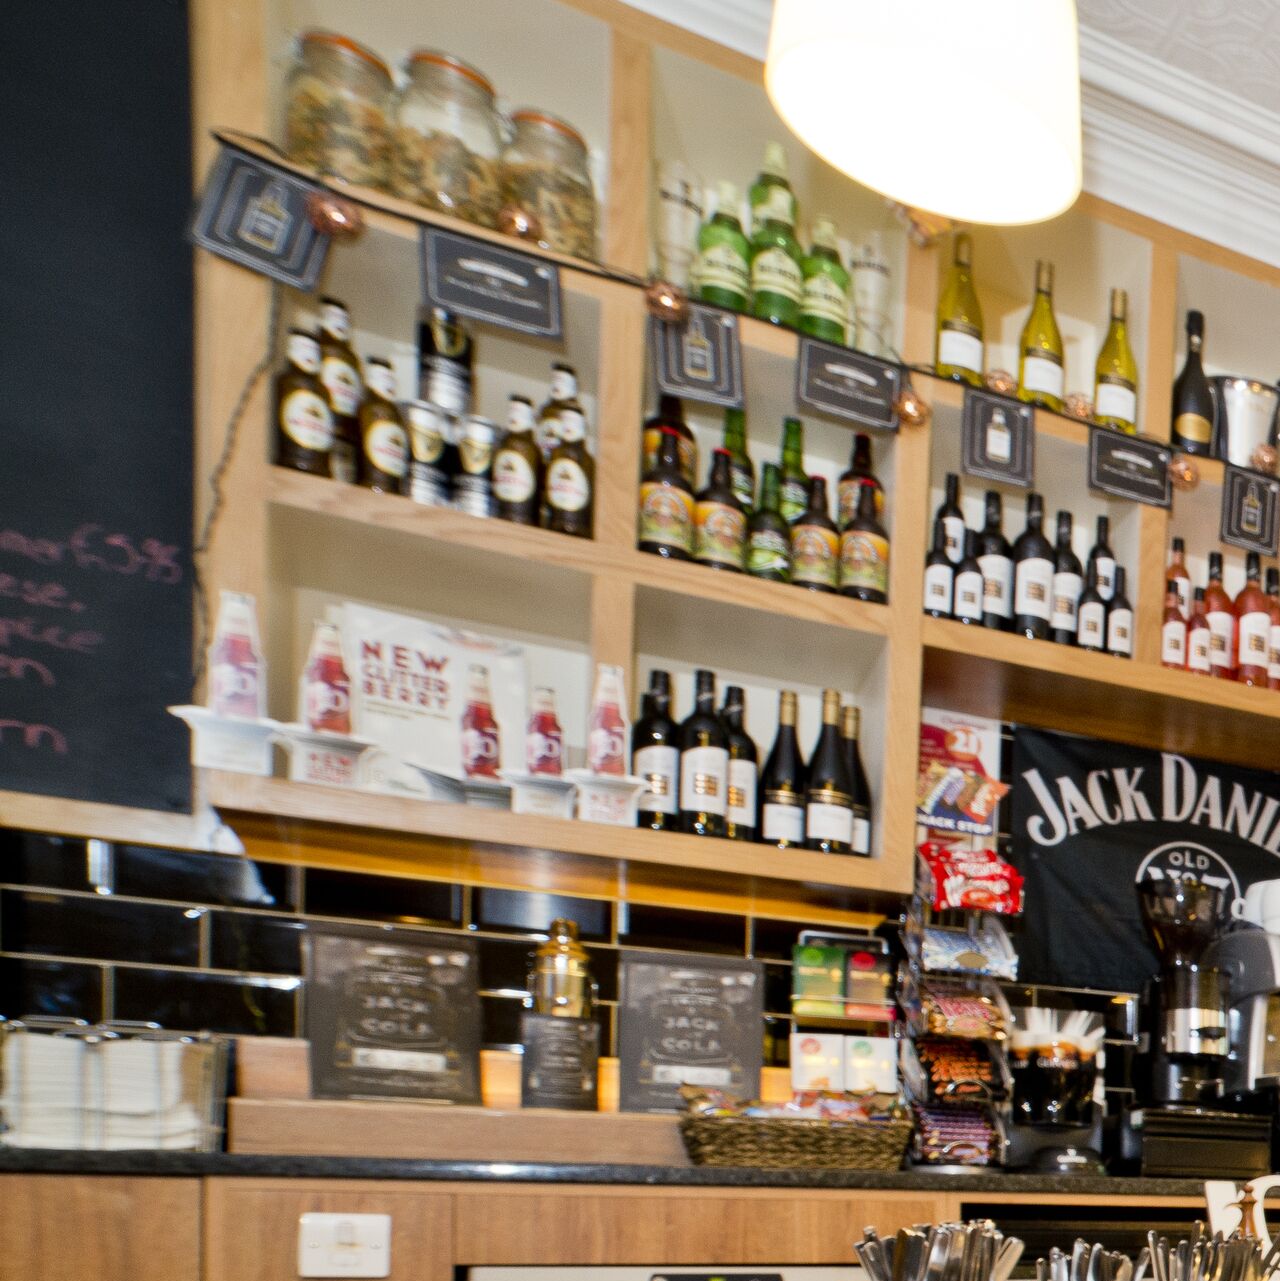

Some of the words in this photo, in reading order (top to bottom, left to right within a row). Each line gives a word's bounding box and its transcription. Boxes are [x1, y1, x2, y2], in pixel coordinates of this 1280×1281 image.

[361, 640, 449, 672] NEW
[363, 680, 448, 709] BERRY
[1022, 767, 1155, 846] JACK
[1168, 849, 1209, 871] OLD
[361, 1018, 432, 1036] COLA
